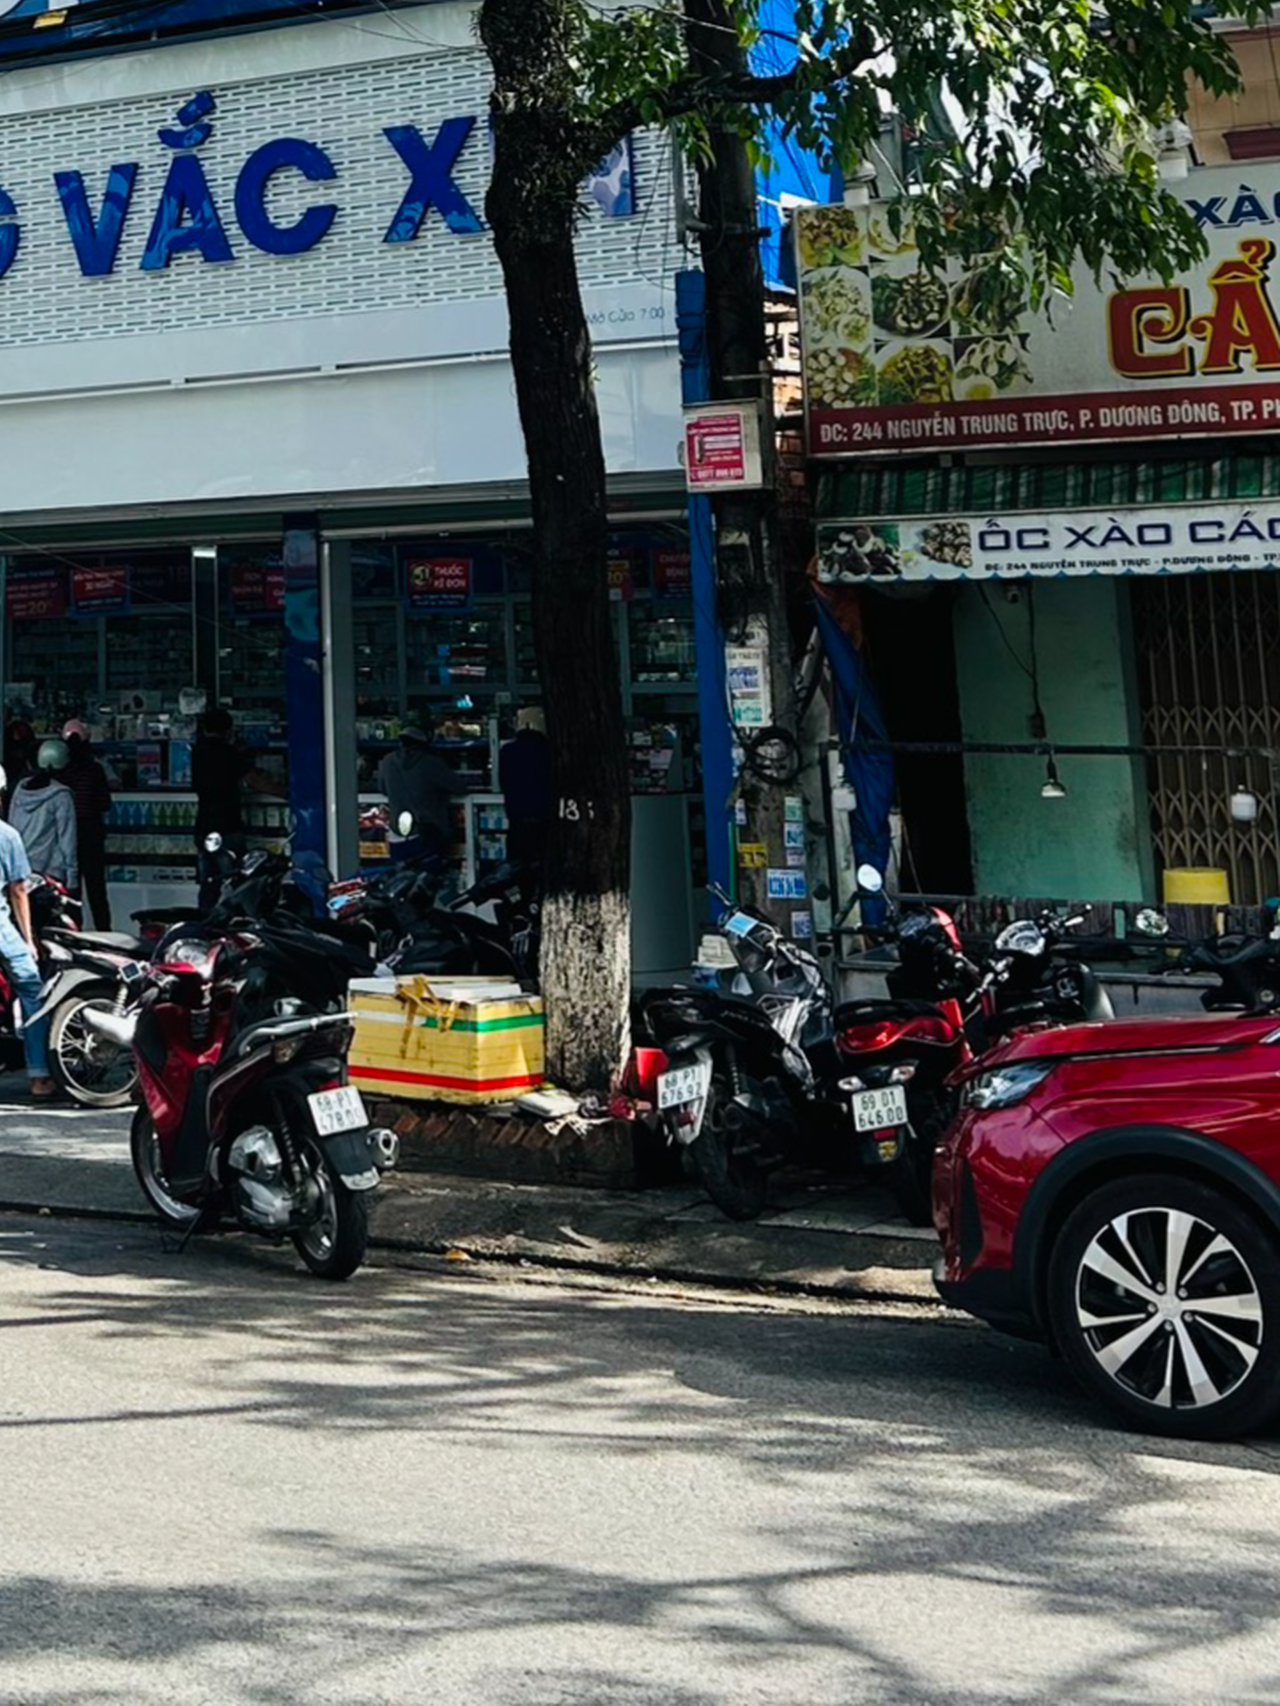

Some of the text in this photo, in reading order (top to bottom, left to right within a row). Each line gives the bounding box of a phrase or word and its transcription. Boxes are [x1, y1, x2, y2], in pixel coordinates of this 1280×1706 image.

[54, 90, 340, 277] VẮC
[820, 422, 848, 444] ĐC:
[852, 423, 883, 441] 244
[888, 410, 956, 440] NGUYỄN
[960, 413, 1019, 436] TRUNG
[1023, 409, 1075, 435] TRỰC,
[1079, 409, 1094, 429] P.
[1100, 404, 1163, 428] DƯƠNG
[1167, 398, 1226, 425] ĐÔNG,
[1230, 399, 1259, 422] TP.
[978, 511, 1280, 552] ỐC XÀO CÁ
